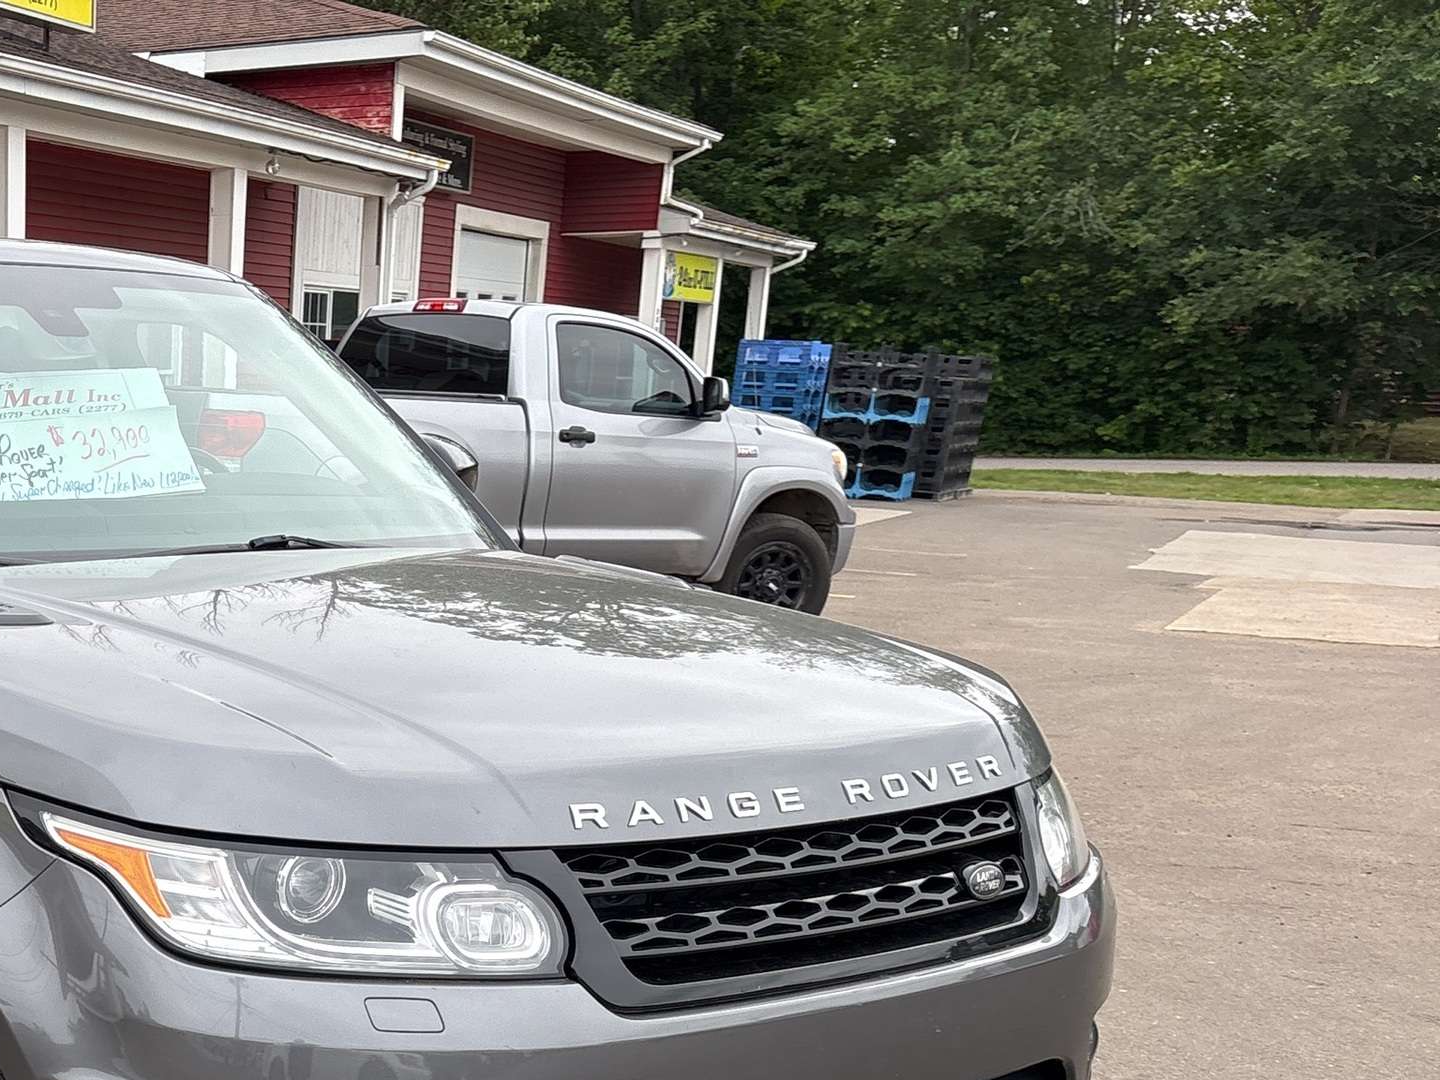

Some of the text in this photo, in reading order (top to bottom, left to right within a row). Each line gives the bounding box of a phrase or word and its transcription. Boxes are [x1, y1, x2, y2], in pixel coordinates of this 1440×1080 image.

[0, 387, 78, 410] Mall
[87, 388, 122, 403] Inc
[78, 402, 127, 415] (2277)
[568, 753, 1004, 830] RANGE ROVER
